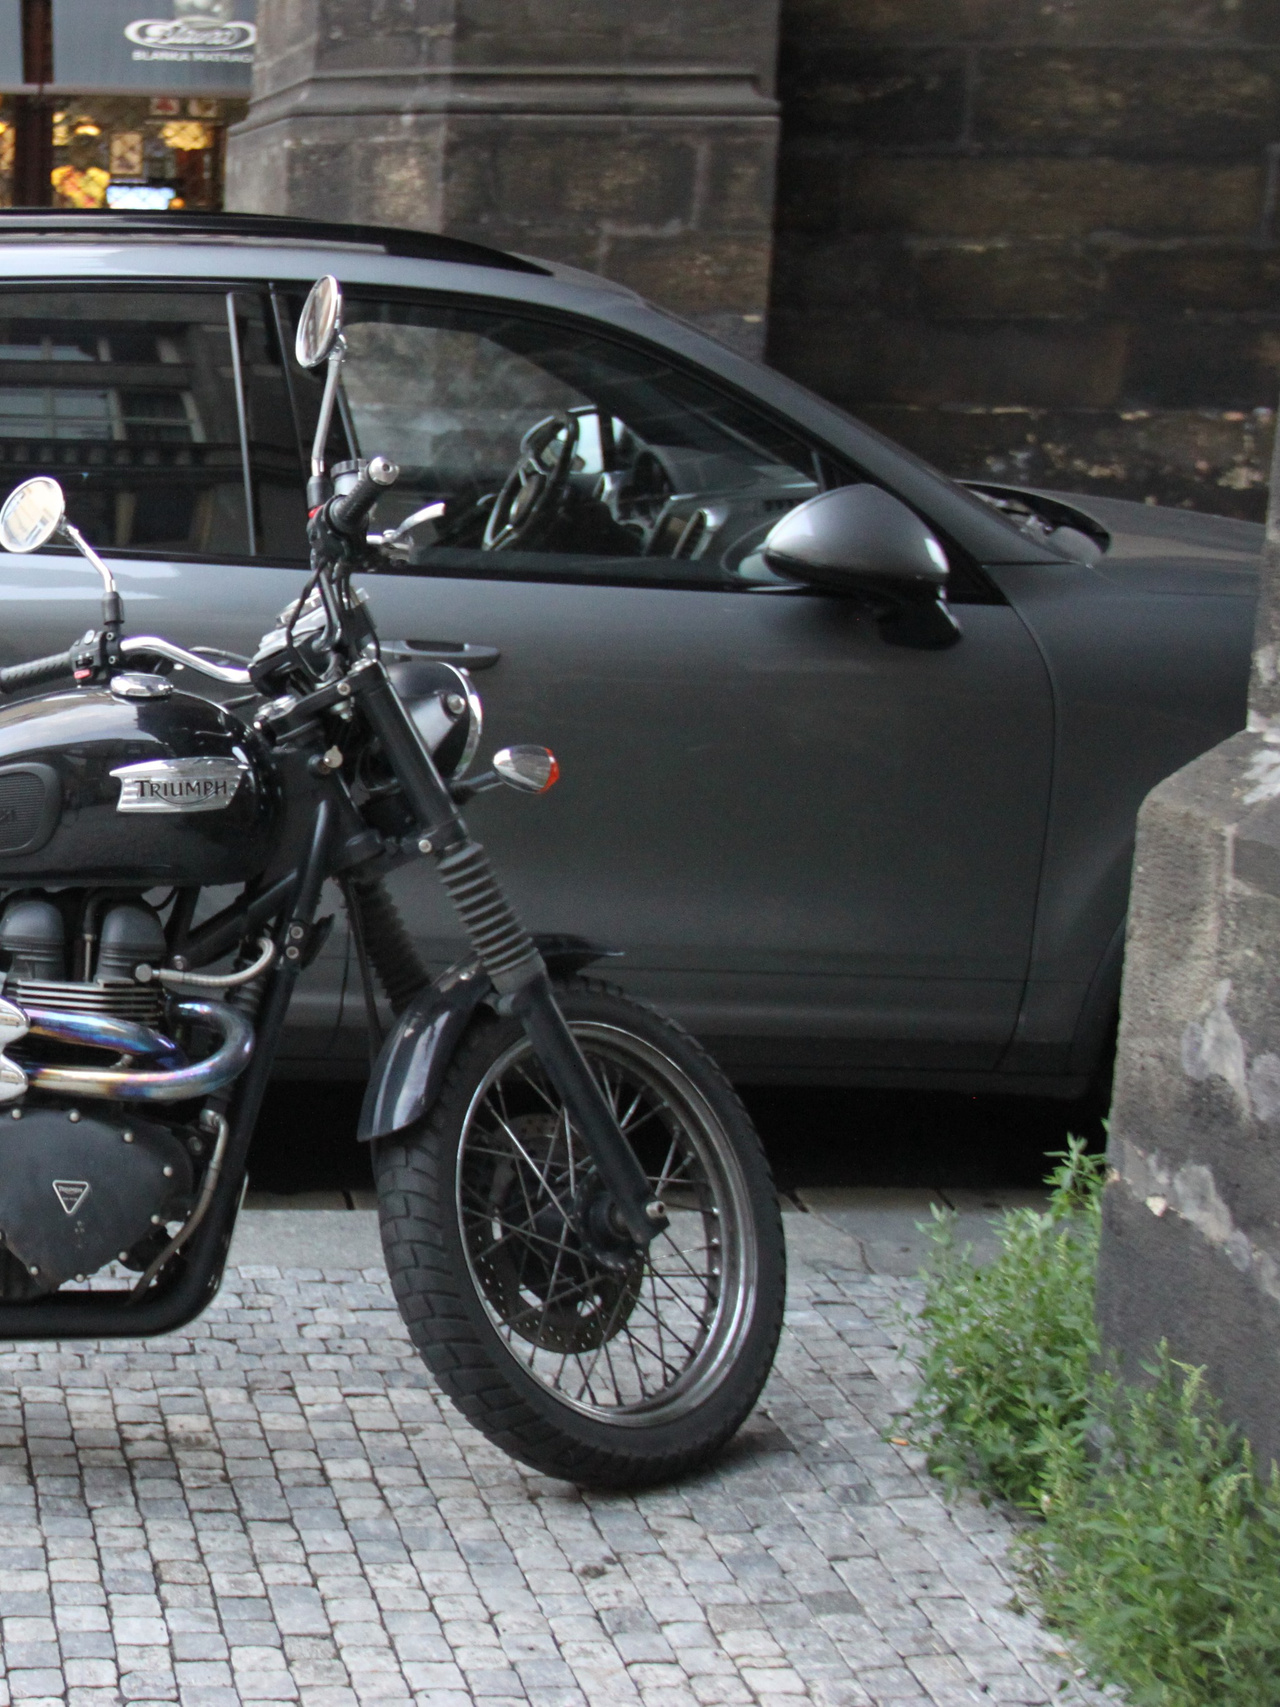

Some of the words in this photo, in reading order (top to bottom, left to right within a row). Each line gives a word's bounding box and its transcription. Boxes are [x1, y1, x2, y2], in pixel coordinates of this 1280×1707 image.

[131, 50, 190, 61] BLANKA
[192, 51, 255, 63] MATRAG
[134, 779, 227, 797] TRIUMPH
